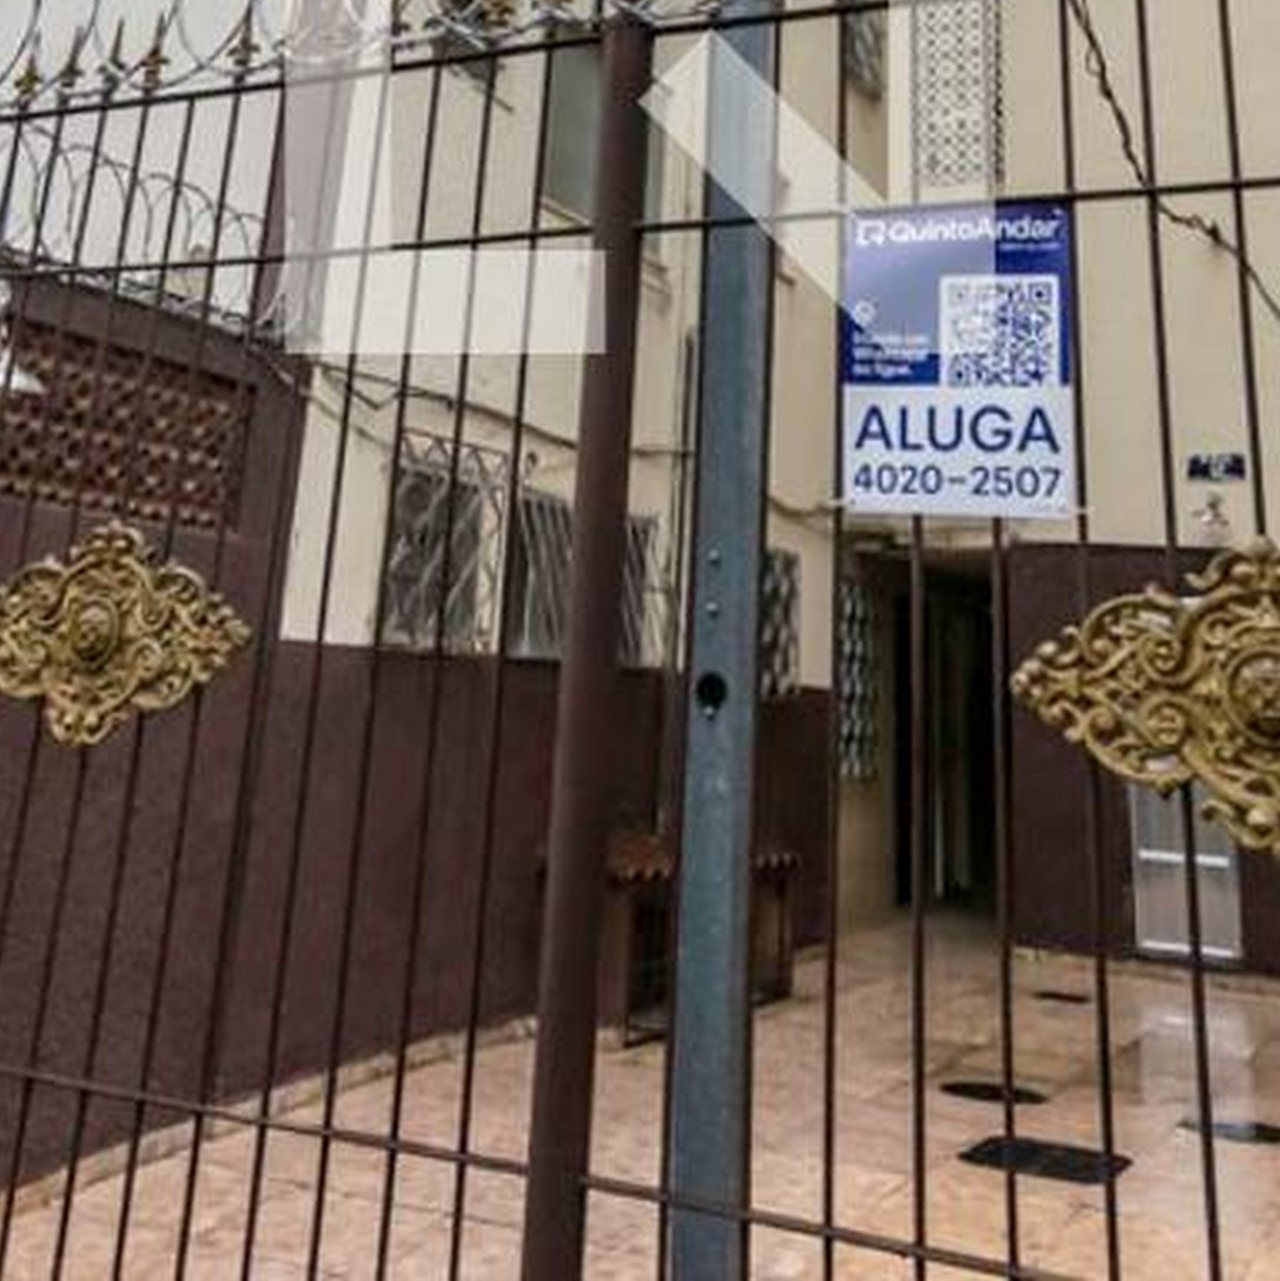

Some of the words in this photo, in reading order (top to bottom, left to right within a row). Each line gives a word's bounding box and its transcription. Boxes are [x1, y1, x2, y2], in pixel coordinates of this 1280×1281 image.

[888, 216, 1060, 242] QuintoAndar
[855, 404, 1061, 453] ALUGA
[853, 464, 1062, 498] 4020-2507
